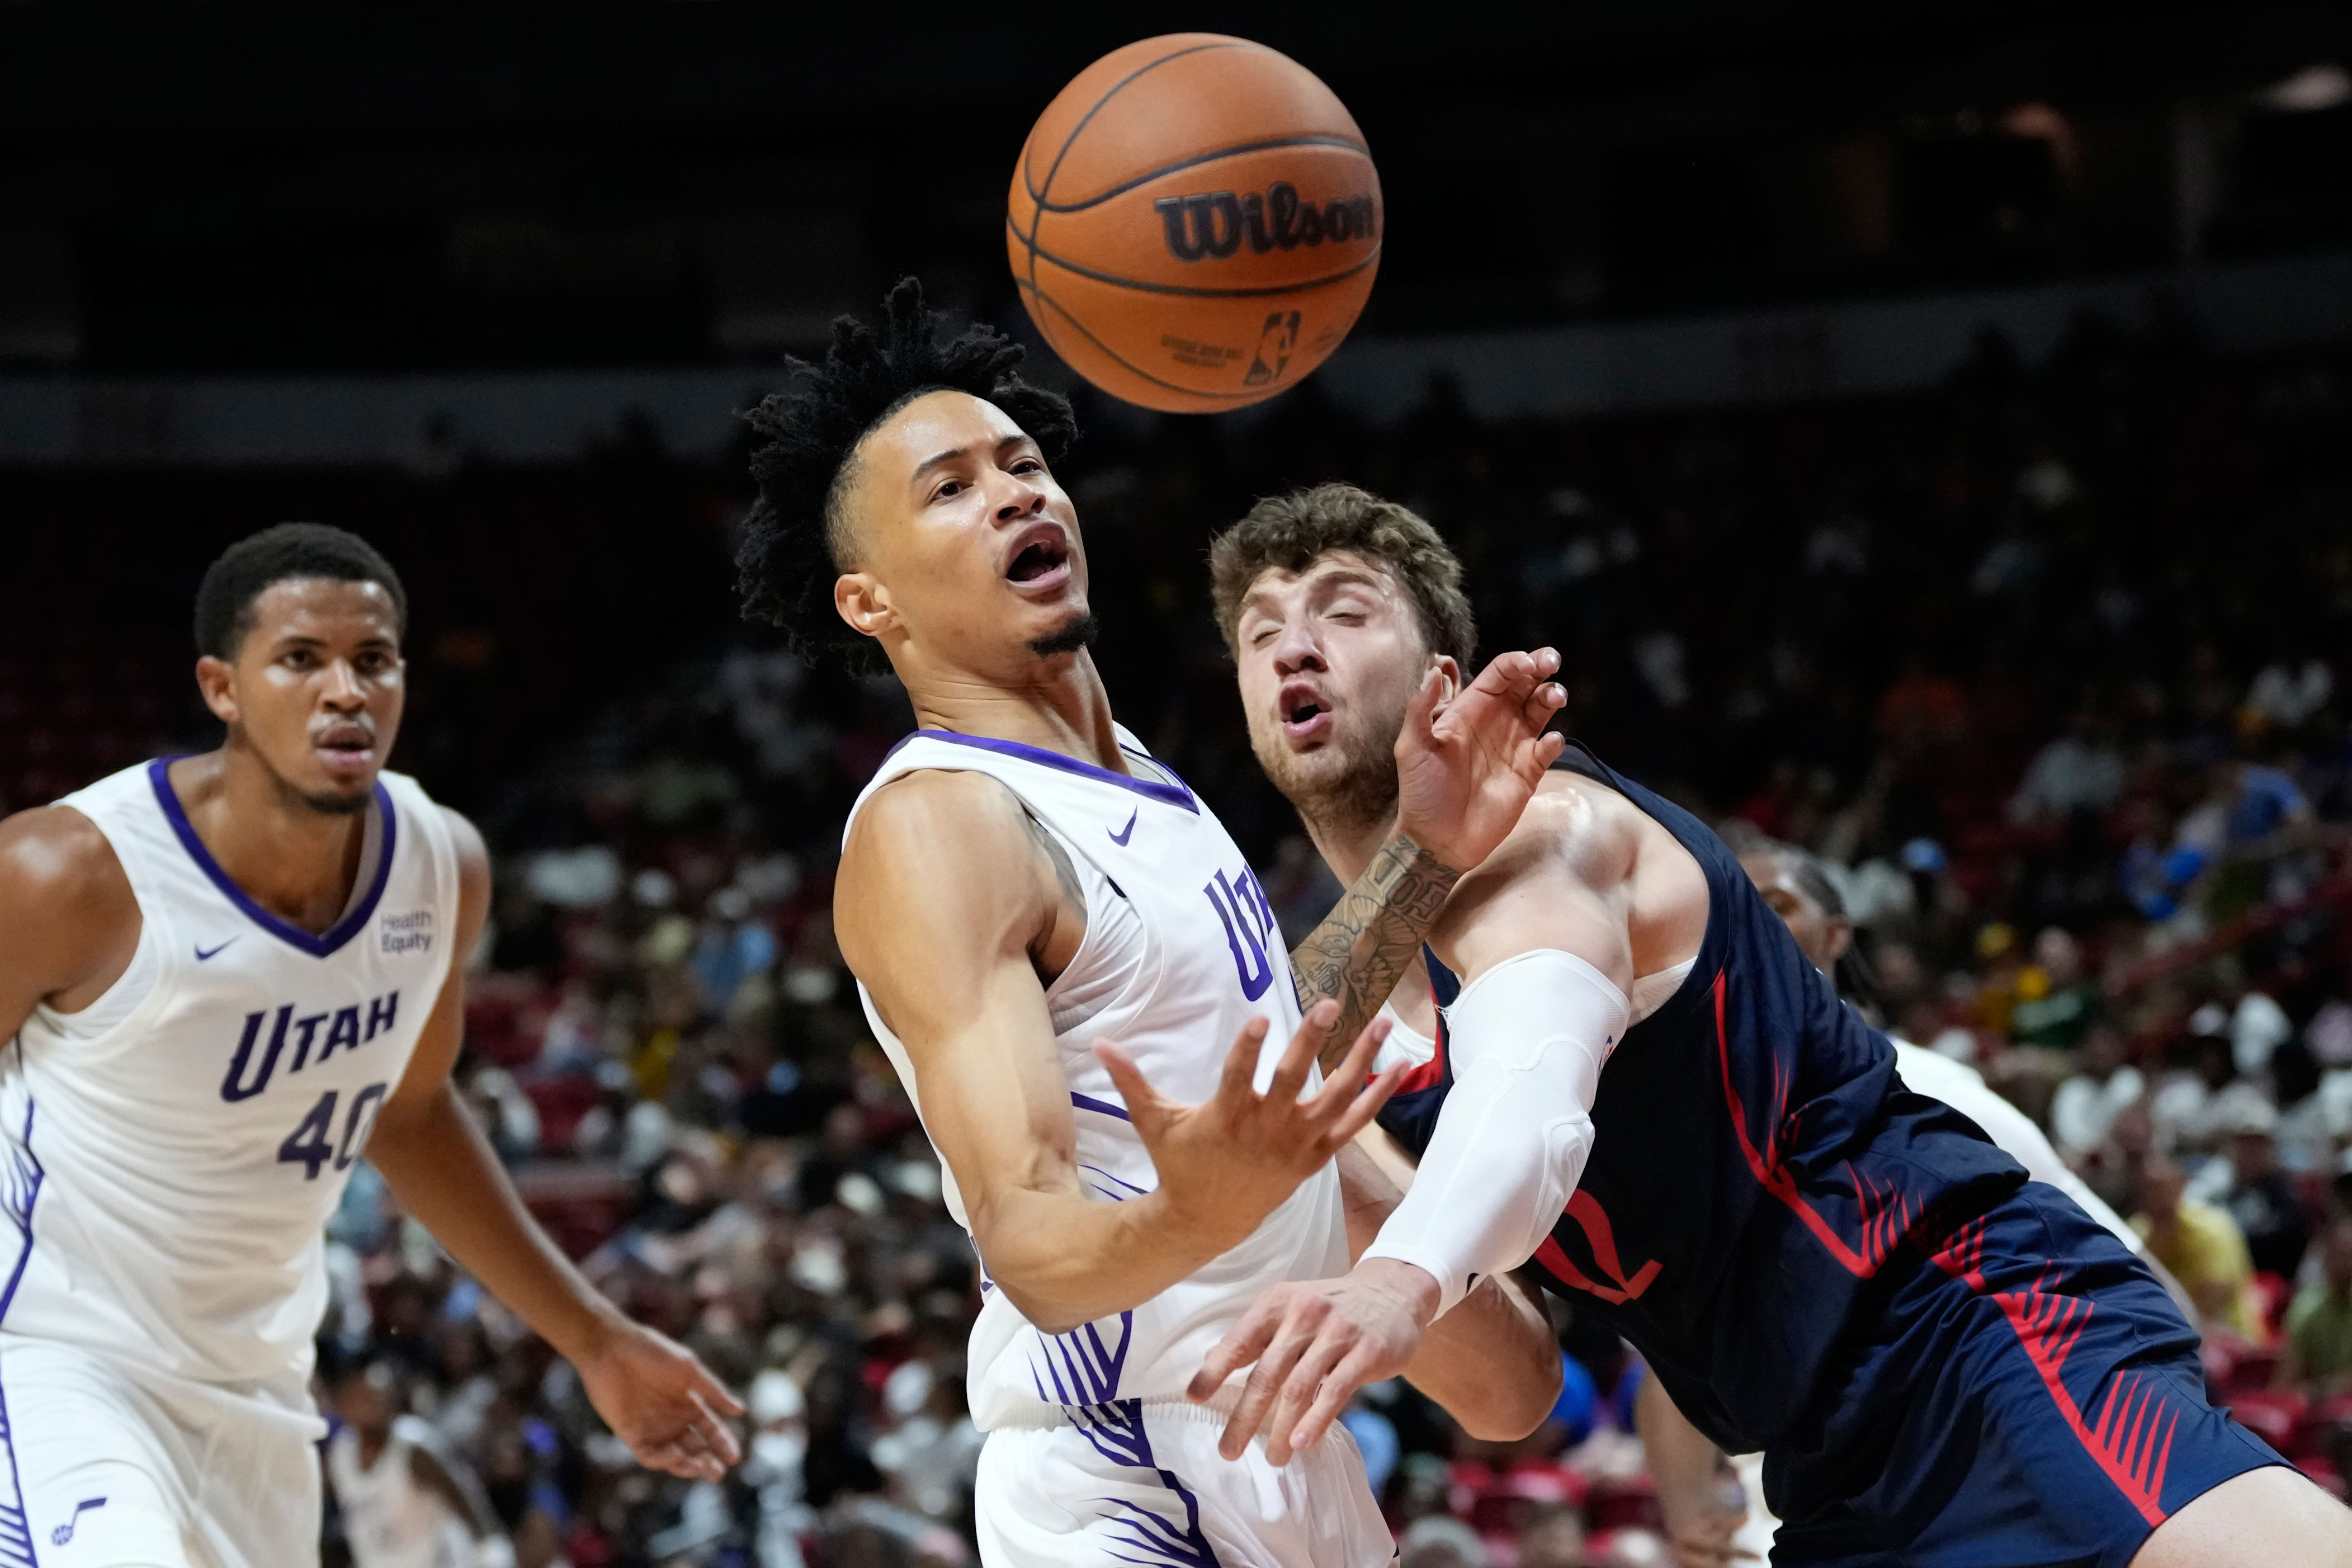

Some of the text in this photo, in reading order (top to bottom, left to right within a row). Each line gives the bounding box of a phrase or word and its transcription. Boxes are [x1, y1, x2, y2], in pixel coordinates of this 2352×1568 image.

[1155, 182, 1375, 263] Wilson
[381, 909, 432, 930] Health
[381, 932, 434, 955] Equity
[220, 989, 400, 1103] UTAH
[277, 1083, 388, 1181] 40
